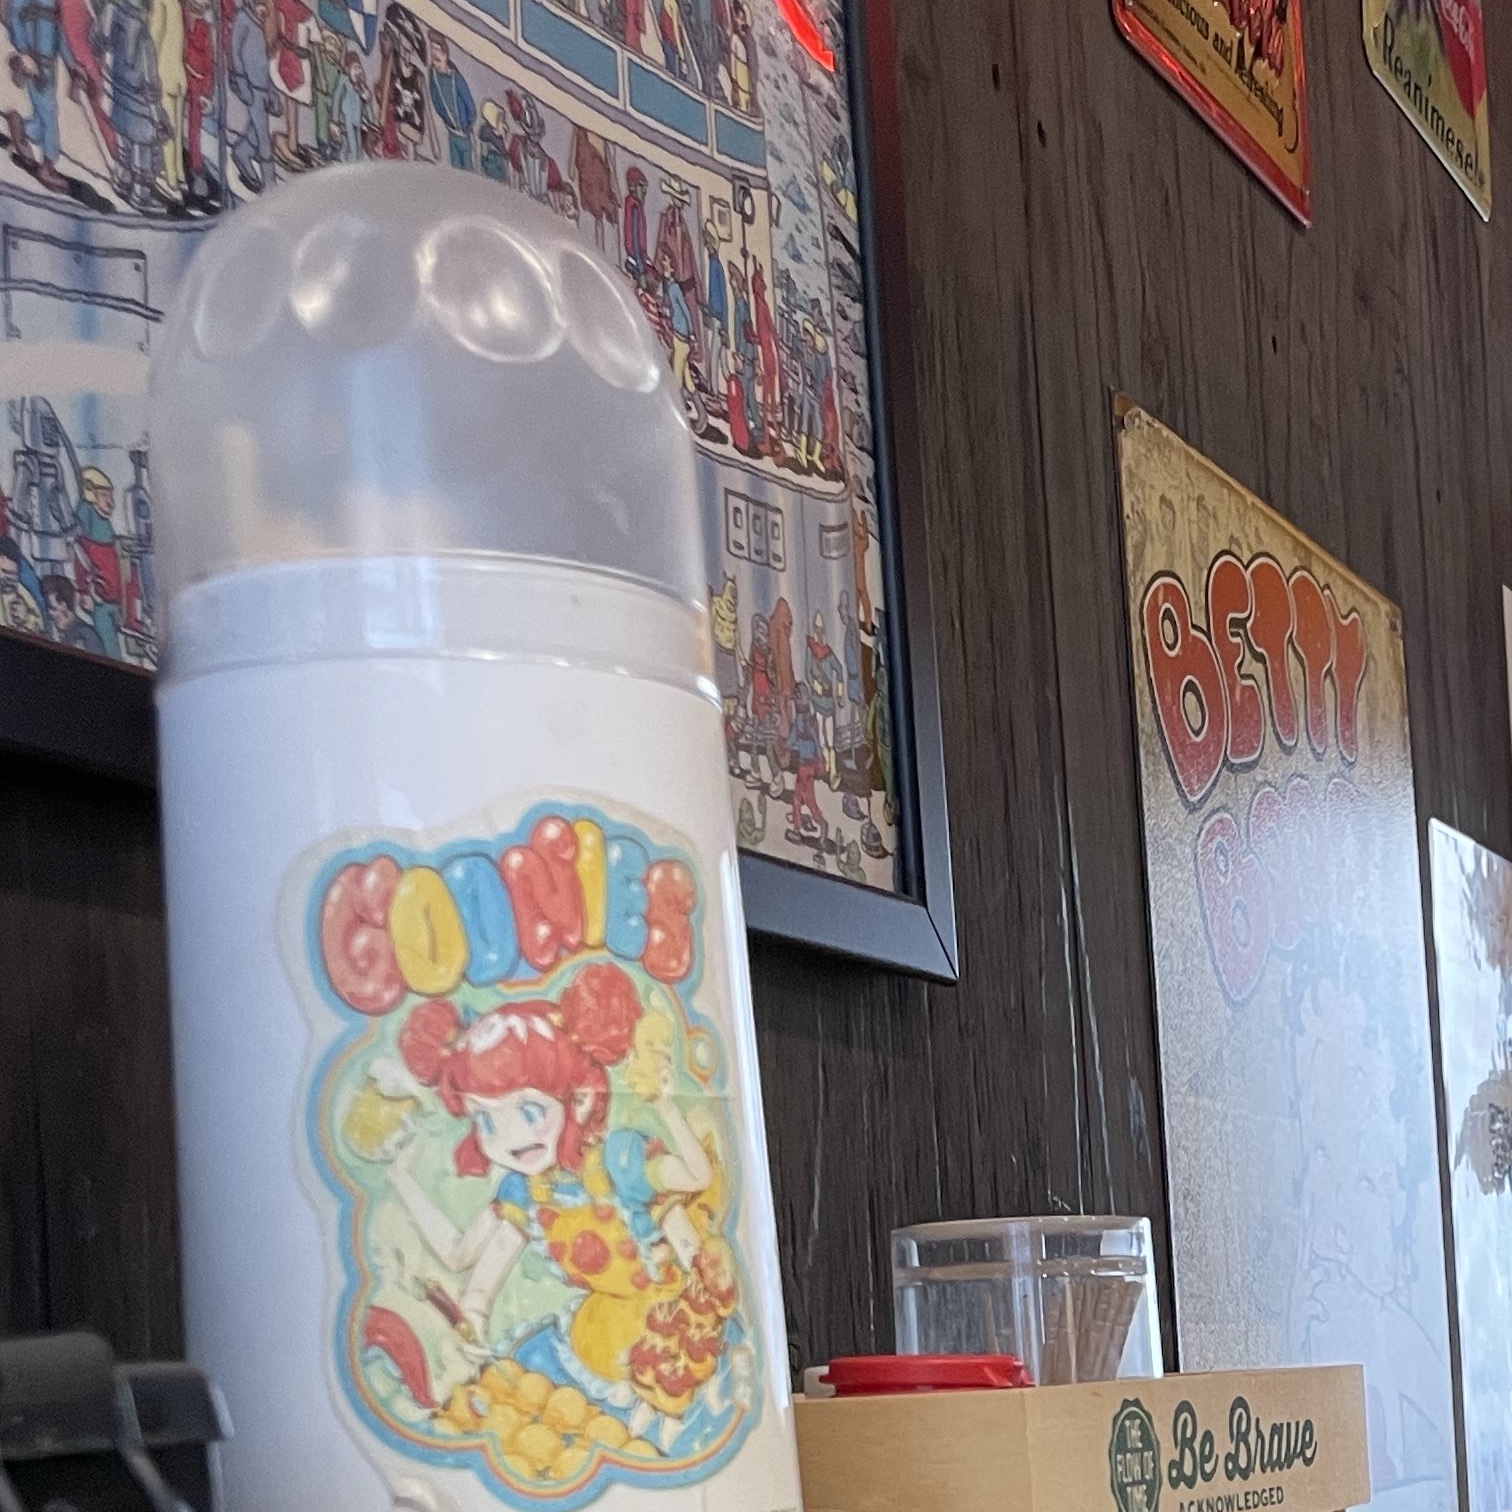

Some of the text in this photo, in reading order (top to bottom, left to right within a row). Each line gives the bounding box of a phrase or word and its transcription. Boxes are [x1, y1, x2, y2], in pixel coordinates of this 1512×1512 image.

[1212, 31, 1233, 66] and
[1141, 553, 1366, 814] BETTY
[1168, 1396, 1318, 1490] Be Brave
